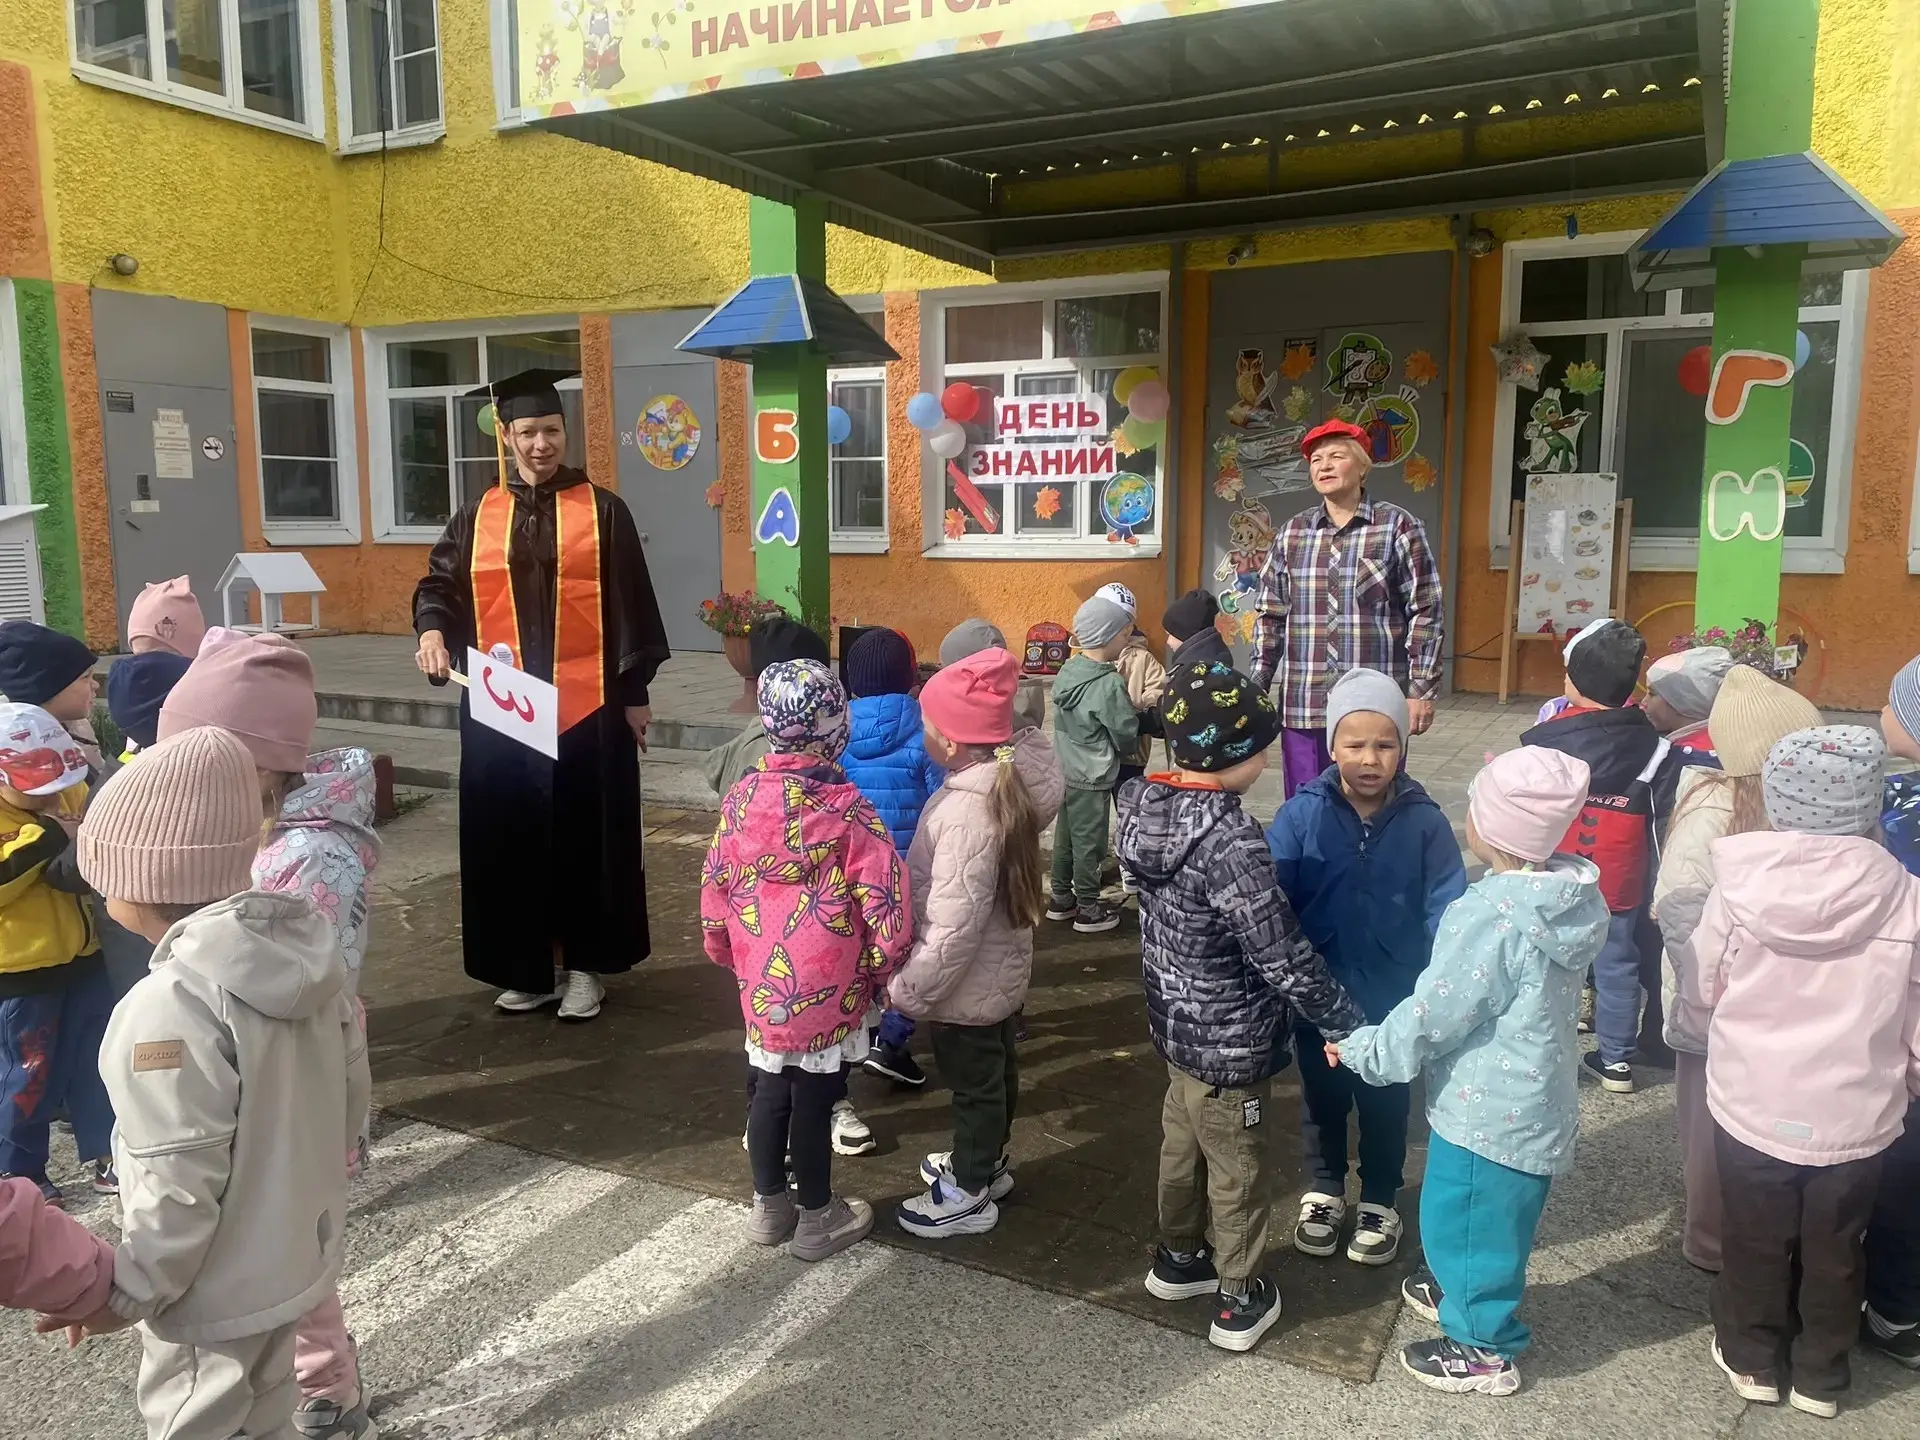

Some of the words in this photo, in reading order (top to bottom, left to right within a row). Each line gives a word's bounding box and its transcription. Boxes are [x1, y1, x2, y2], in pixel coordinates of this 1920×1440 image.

[692, 0, 1010, 58] НАЧИНАЕ
[1705, 350, 1794, 425] Г
[754, 410, 799, 463] Б
[999, 402, 1100, 434] ДЕНЬ
[971, 440, 1114, 477] ЗНАНИЙ
[755, 487, 799, 546] А
